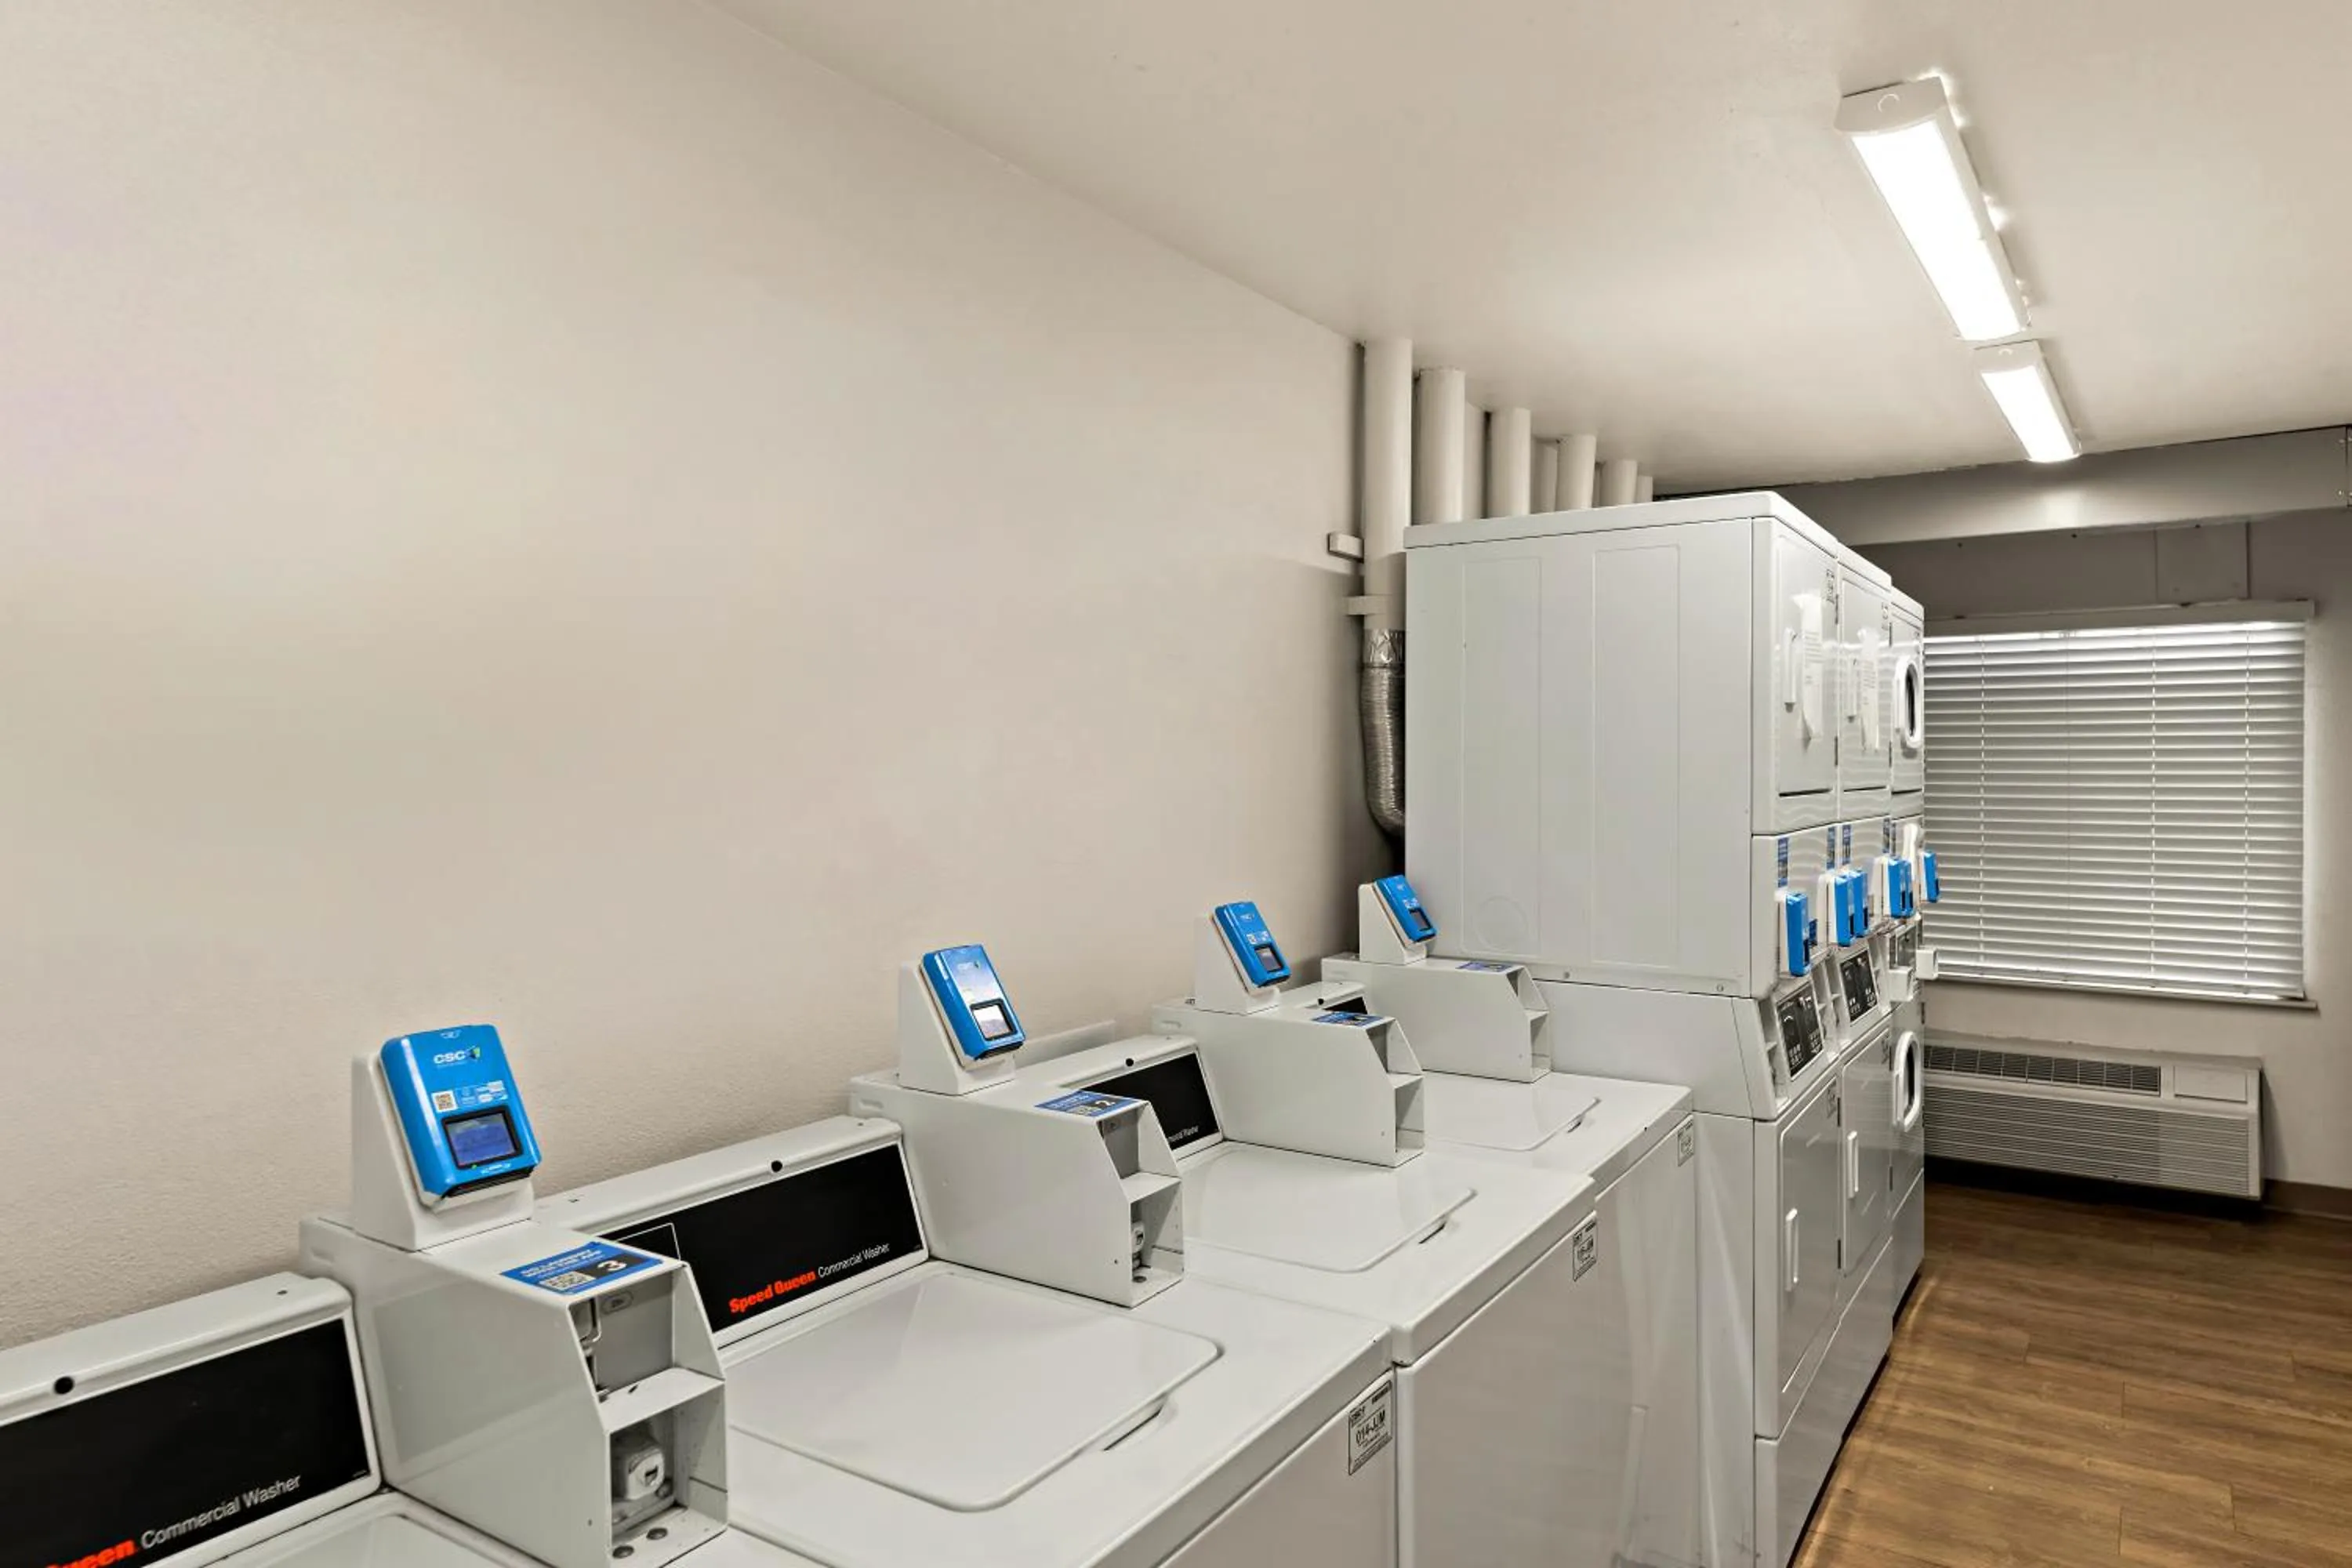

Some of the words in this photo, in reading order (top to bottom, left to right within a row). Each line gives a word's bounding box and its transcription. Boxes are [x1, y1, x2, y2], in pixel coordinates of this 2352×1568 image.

[434, 1050, 464, 1064] CSC
[597, 1260, 627, 1272] 3
[729, 1284, 773, 1312] Speed
[774, 1271, 816, 1294] Queen
[818, 1252, 862, 1279] Commercial
[862, 1243, 890, 1260] Washer
[45, 1540, 135, 1568] een
[141, 1496, 241, 1549] Commercial
[242, 1475, 301, 1508] Washer
